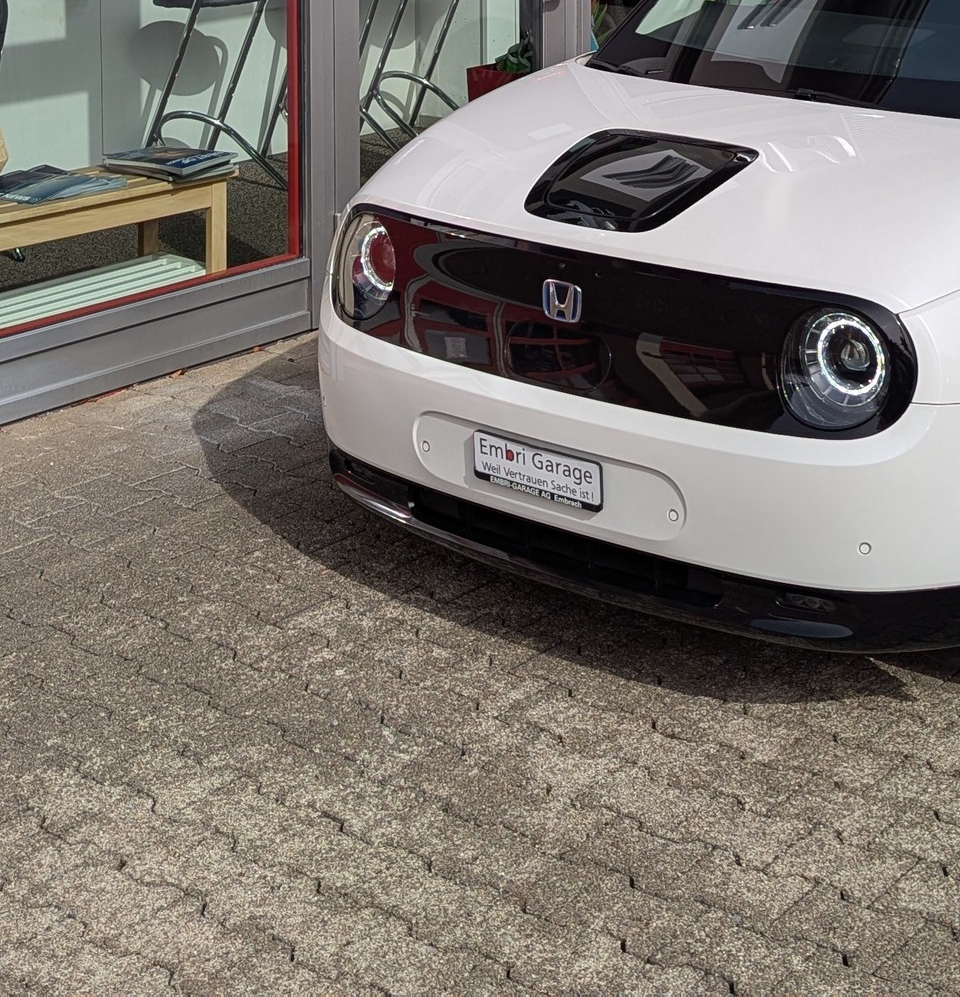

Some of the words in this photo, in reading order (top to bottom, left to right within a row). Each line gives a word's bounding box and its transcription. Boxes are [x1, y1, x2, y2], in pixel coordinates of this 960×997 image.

[480, 438, 526, 465] Embri
[532, 452, 593, 485] Garage
[482, 461, 500, 473] Weil
[504, 467, 549, 488] Vertrauen
[551, 480, 578, 497] Sache
[541, 491, 551, 500] AG
[554, 495, 582, 509] Embrach
